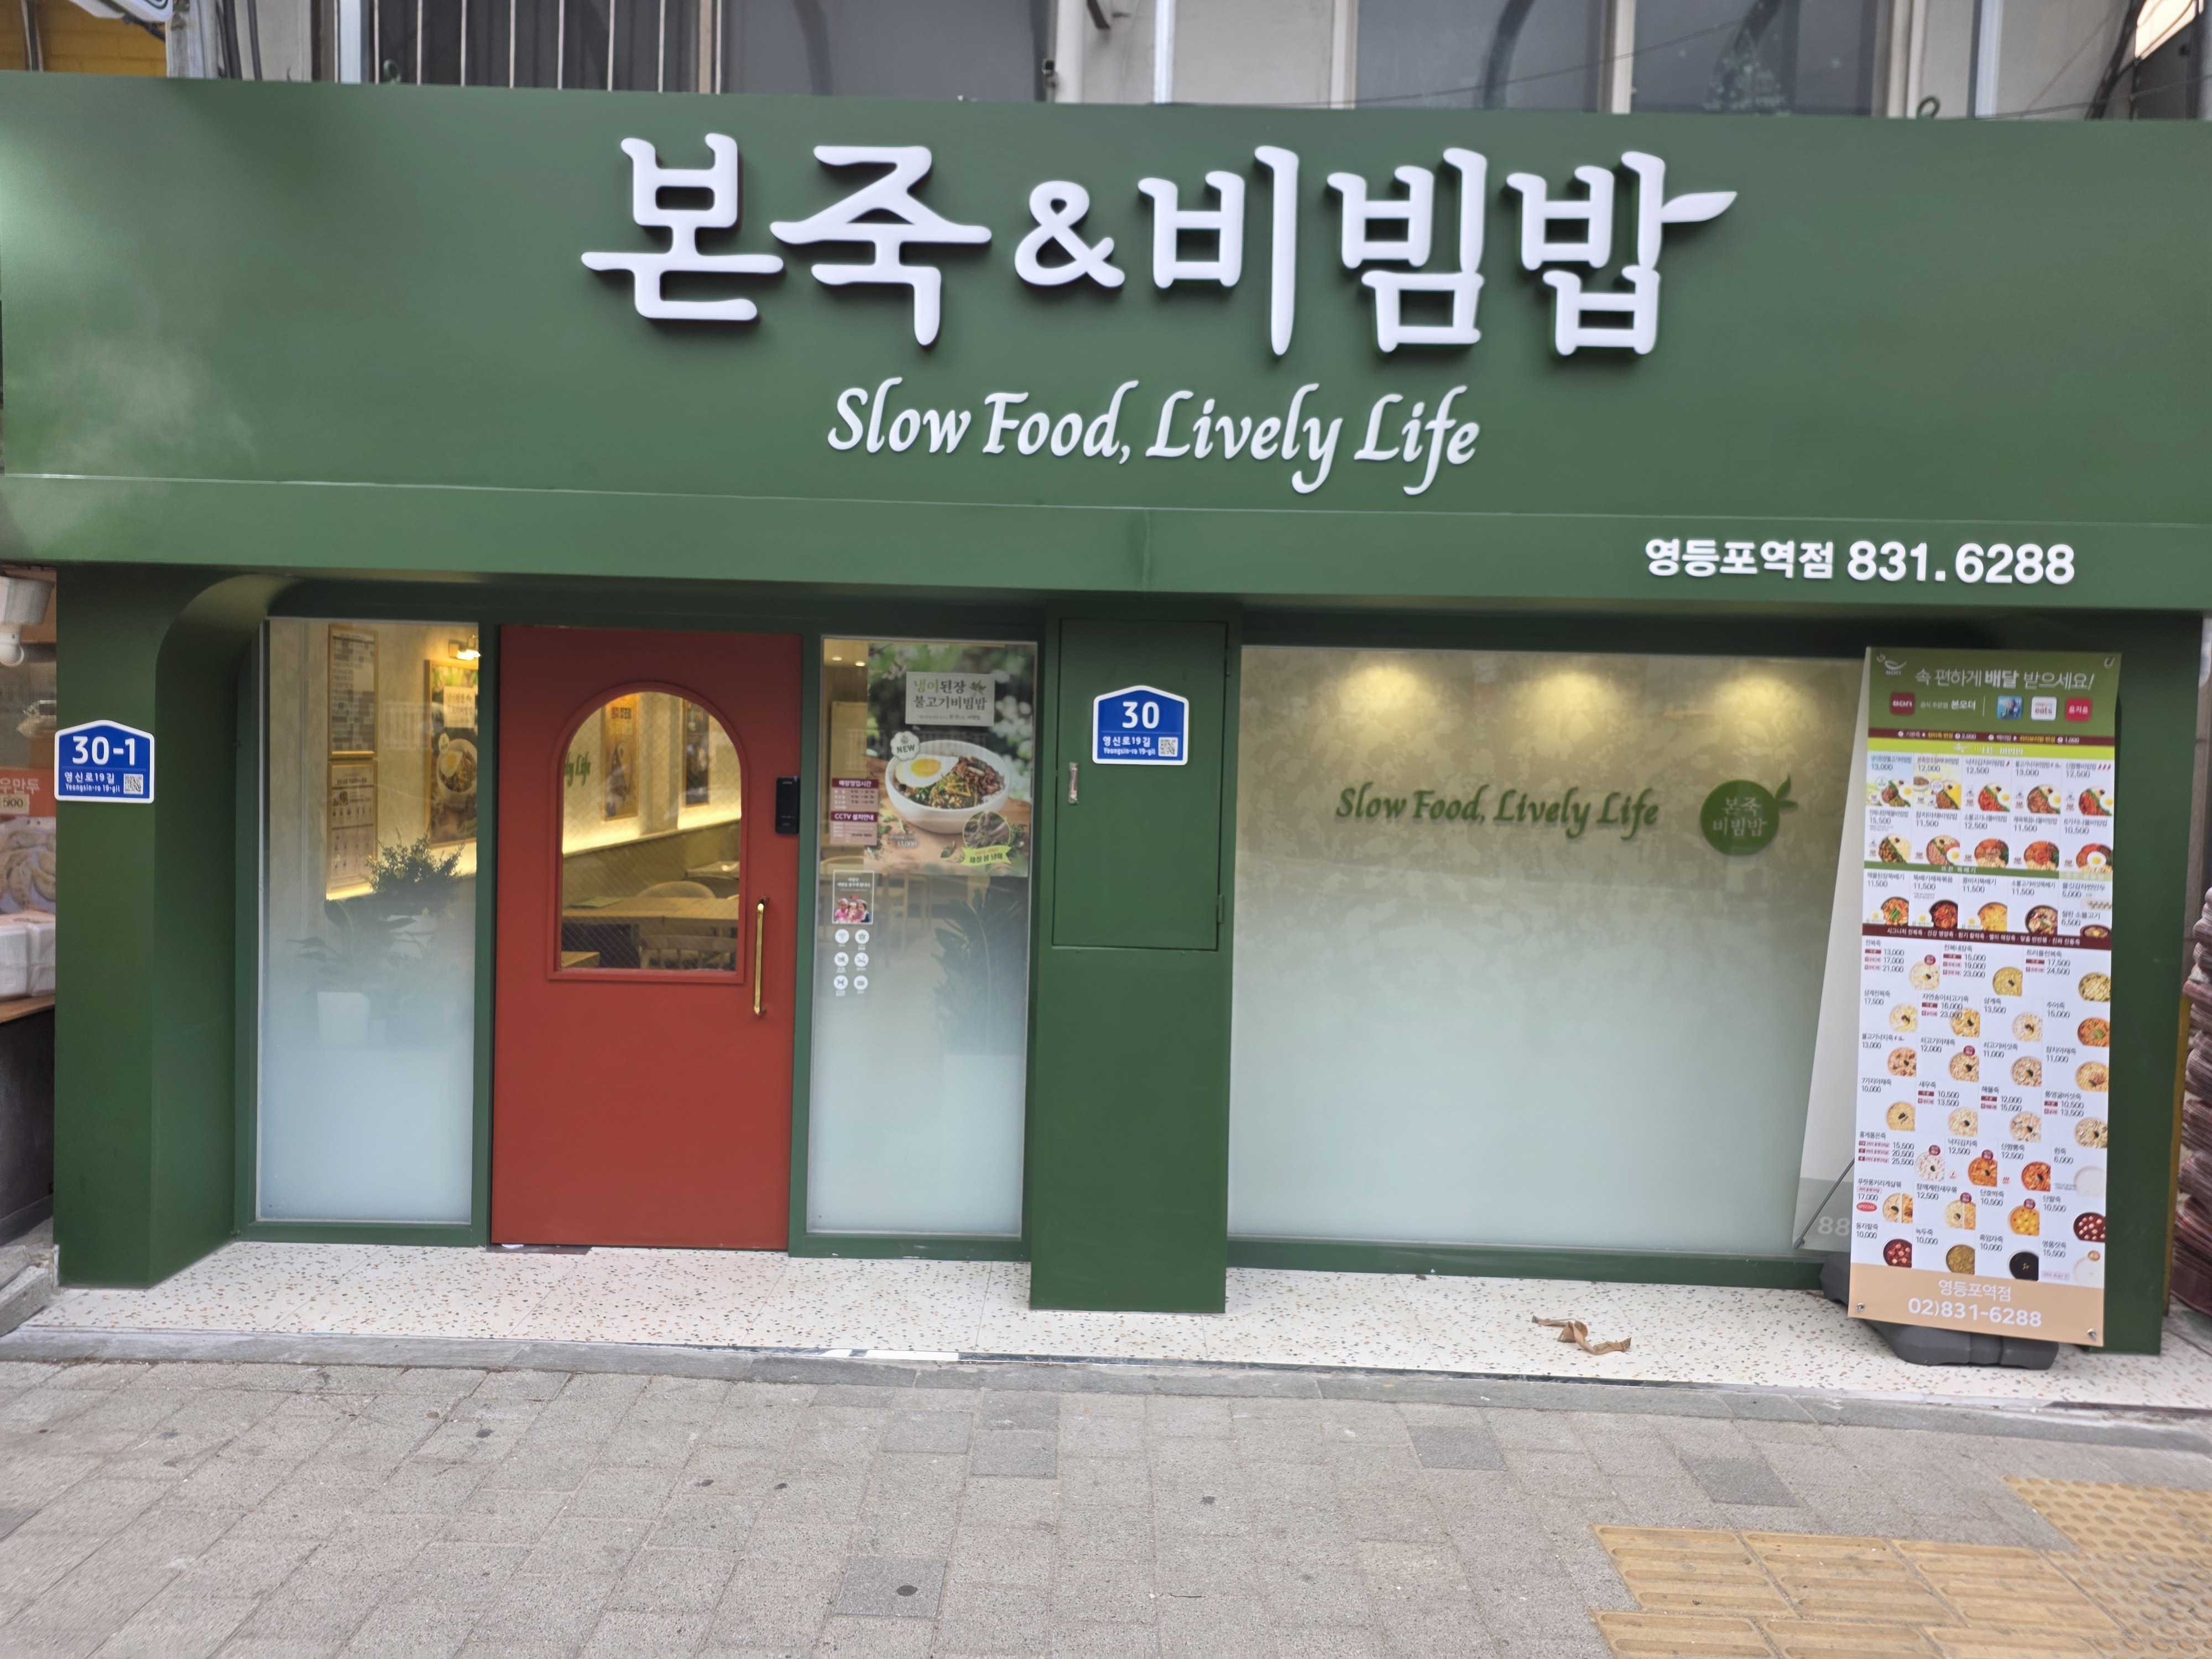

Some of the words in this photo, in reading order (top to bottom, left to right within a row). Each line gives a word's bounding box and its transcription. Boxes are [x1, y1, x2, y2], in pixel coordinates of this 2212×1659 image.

[827, 377, 971, 453] Slow
[983, 380, 1138, 465] Food,
[1146, 383, 1343, 494] Lively
[1354, 385, 1480, 495] Life
[1645, 539, 1833, 580] 영등포역점
[1847, 541, 2075, 585] 831.6288
[914, 679, 966, 694] 냉이된장
[1915, 667, 1931, 686] 속
[1935, 668, 1982, 687] 편하게
[1985, 669, 2020, 688] 배달
[2023, 671, 2095, 690] 받으세요!
[914, 695, 988, 711] 불고기비빔밥
[2034, 706, 2052, 714] eats
[2068, 705, 2089, 714] 요기요
[1122, 701, 1160, 729] 30
[72, 735, 135, 766] 30-1
[896, 744, 915, 754] NEW
[1103, 736, 1151, 748] 영신로19길
[1139, 748, 1156, 756] 19-gil
[64, 772, 114, 785] 영신로19길
[65, 783, 101, 792] Yeongsin-ro
[102, 784, 121, 794] 19-gil
[1336, 782, 1407, 819] Slow
[1412, 784, 1488, 825] Food,
[1493, 786, 1591, 839] Lively
[1597, 788, 1659, 841] Life
[1724, 796, 1762, 816] 본죽
[1713, 816, 1768, 838] 비빔밥
[1938, 1279, 2011, 1302] 영등포역점
[1907, 1297, 2042, 1327] 02)831-6288
